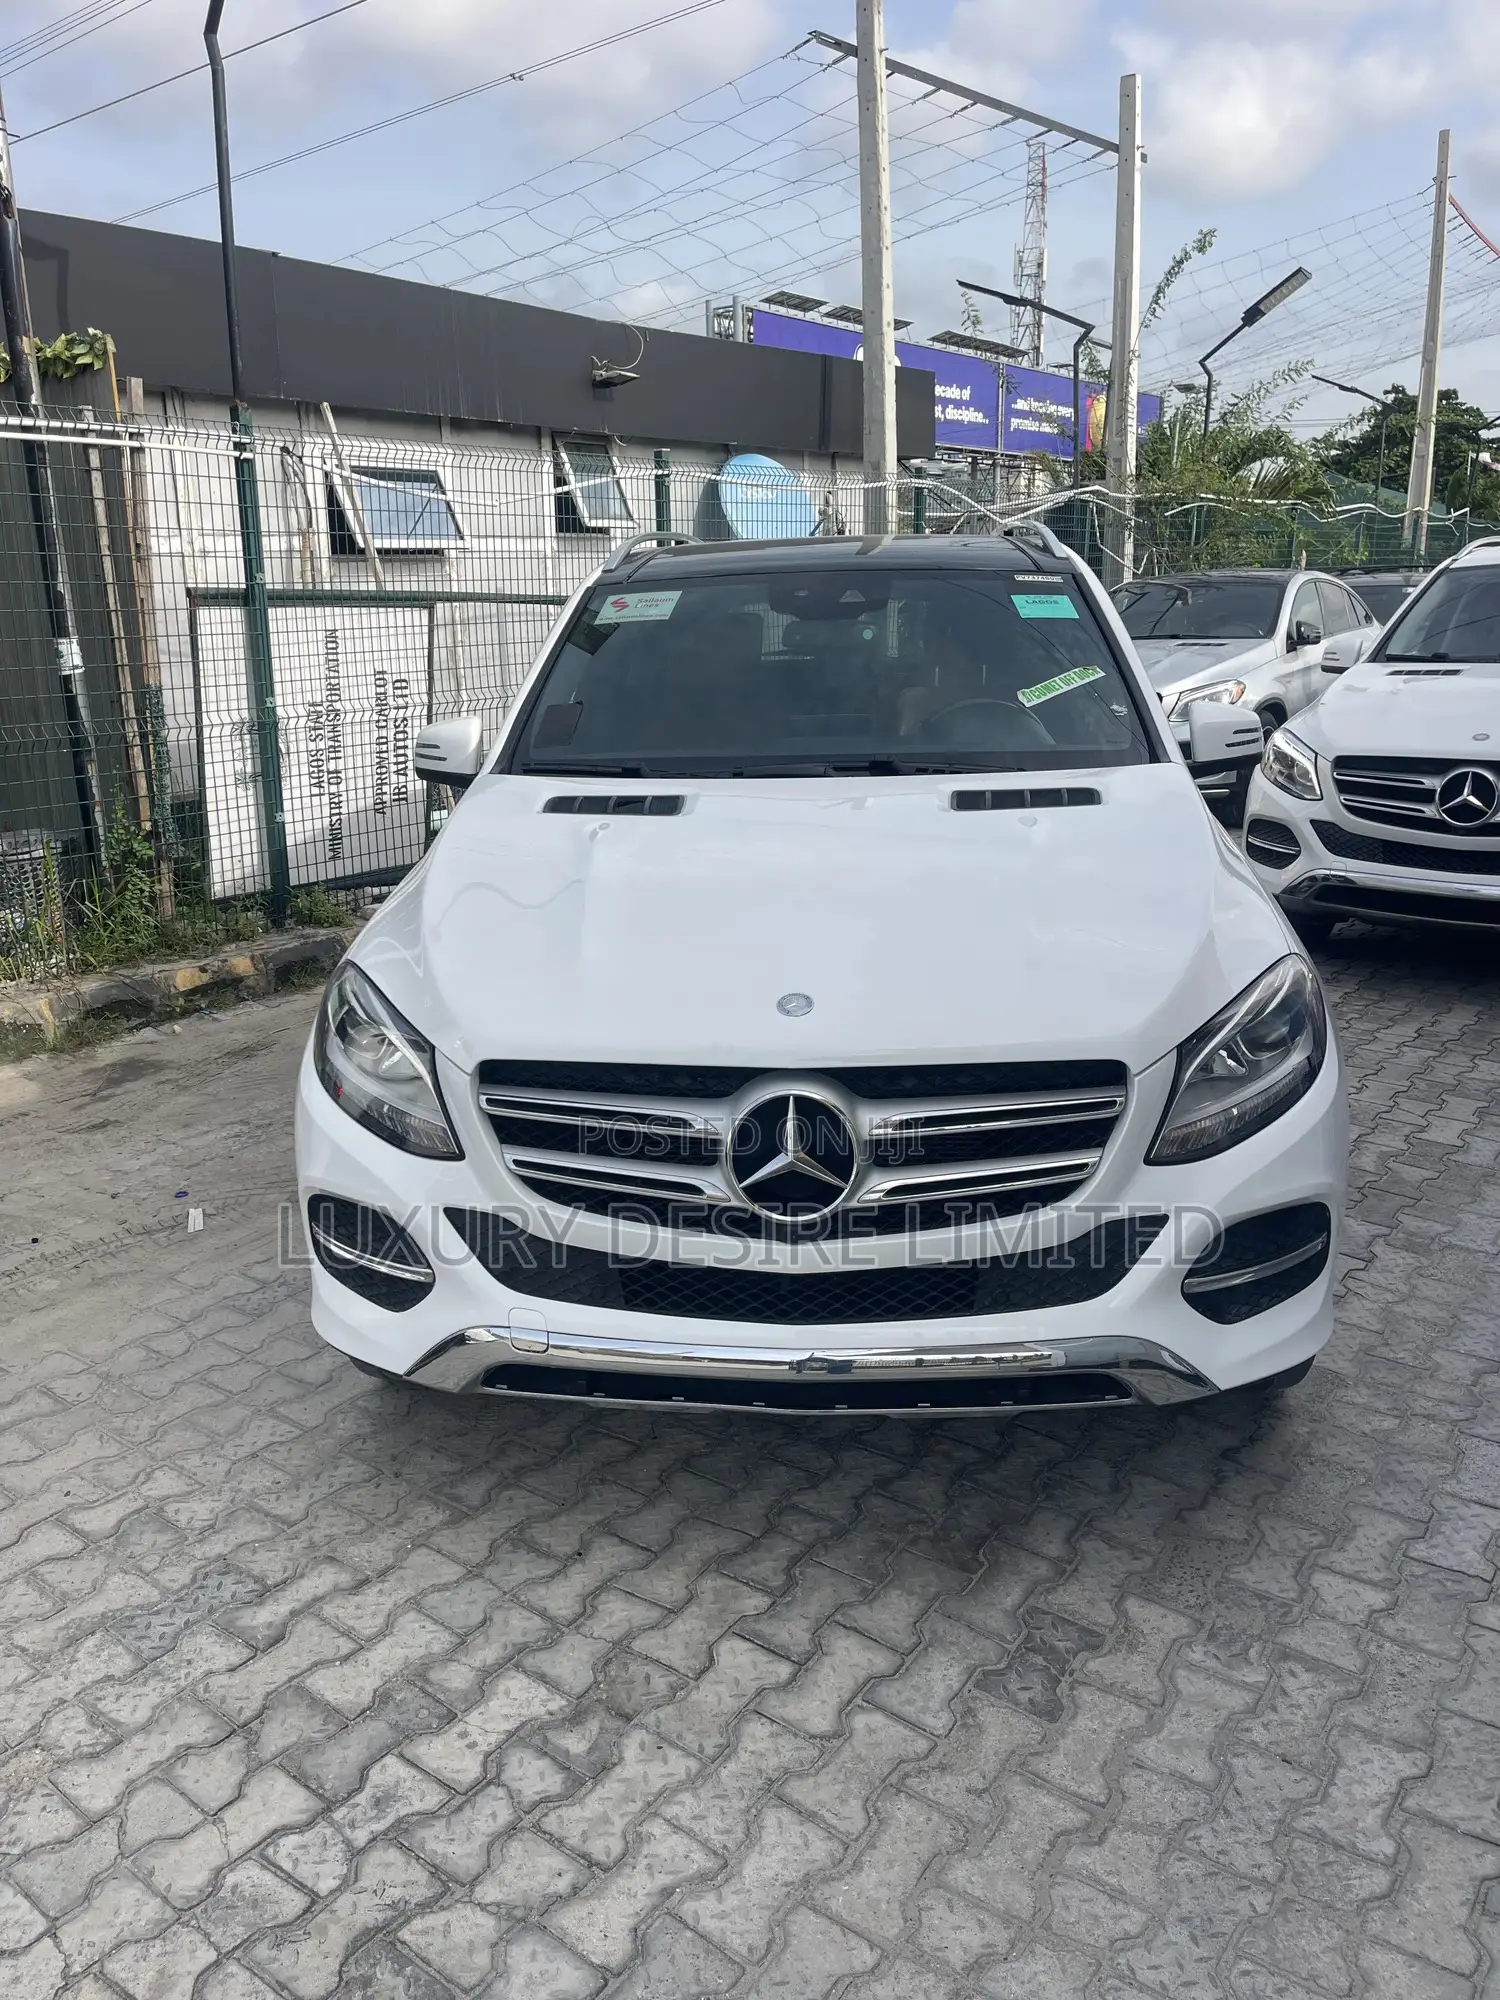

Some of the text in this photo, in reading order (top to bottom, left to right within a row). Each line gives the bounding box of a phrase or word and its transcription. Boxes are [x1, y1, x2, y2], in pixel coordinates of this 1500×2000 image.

[935, 383, 971, 400] ecade of
[392, 678, 409, 709] LTD
[1058, 674, 1078, 687] OFF
[307, 700, 326, 797] LAGOS STATE
[324, 629, 343, 861] MINISTRY OF TRANSPORTATION
[374, 669, 389, 815] APPROVED CARLOT
[392, 717, 409, 777] AUTOS
